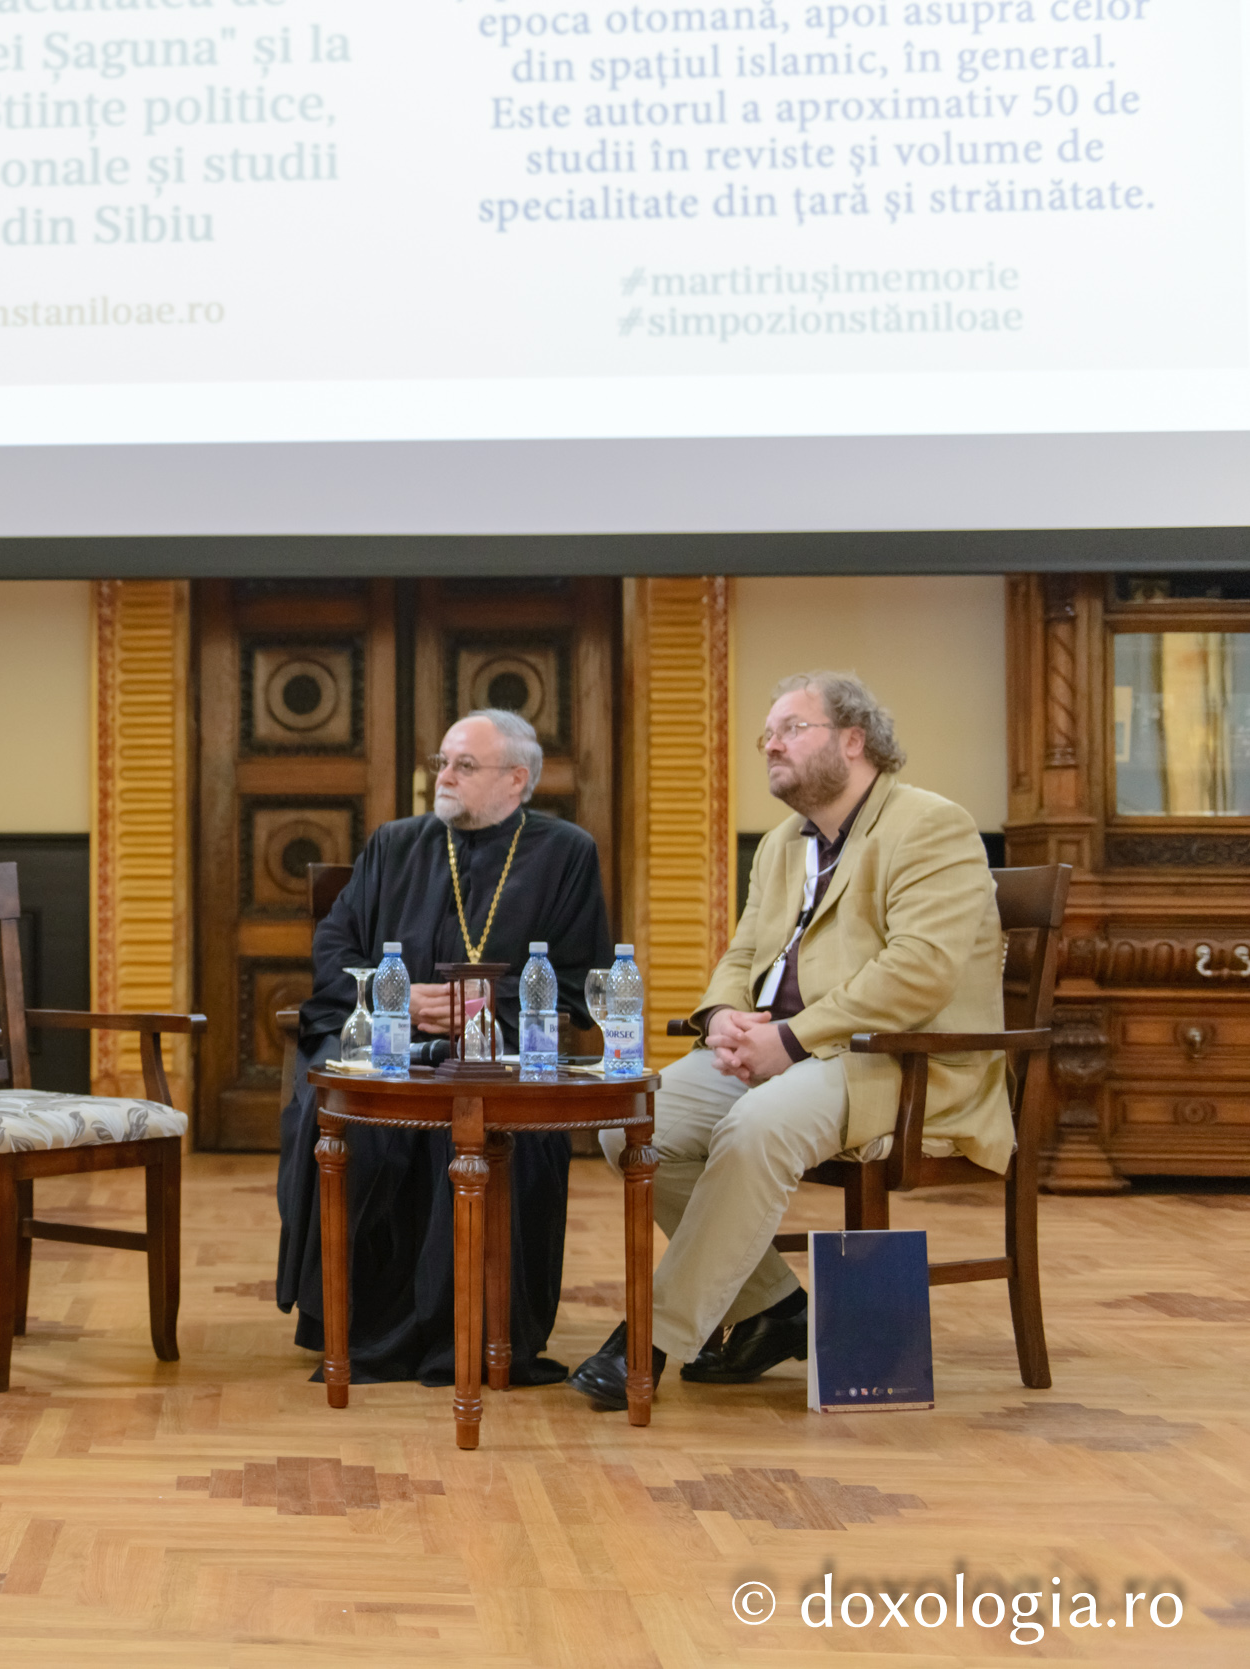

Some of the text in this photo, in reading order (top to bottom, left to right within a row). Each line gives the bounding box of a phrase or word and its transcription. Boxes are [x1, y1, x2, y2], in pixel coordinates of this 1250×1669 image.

[478, 0, 1150, 48] epoca otomană, apoi asupra celor
[253, 26, 292, 78] și
[310, 23, 351, 63] la
[510, 47, 576, 84] din
[736, 41, 888, 80] islamic,
[903, 40, 942, 74] în
[956, 33, 1116, 84] general.
[143, 85, 336, 136] politice,
[491, 79, 1140, 134] Este autorul a aproximativ 50 de
[147, 146, 185, 198] și
[203, 141, 339, 184] studii
[526, 137, 637, 176] studii
[650, 138, 690, 172] în
[705, 137, 835, 171] reviste
[893, 130, 1043, 168] volume
[1057, 127, 1104, 164] de
[1, 206, 77, 246] din
[94, 203, 214, 244] Sibiu
[478, 184, 699, 234] specialitate
[712, 181, 778, 219] din
[929, 178, 1155, 216] străinătate.
[620, 261, 1019, 303] #martiriușimemorie
[617, 301, 1023, 344] #simpozionstăniloae
